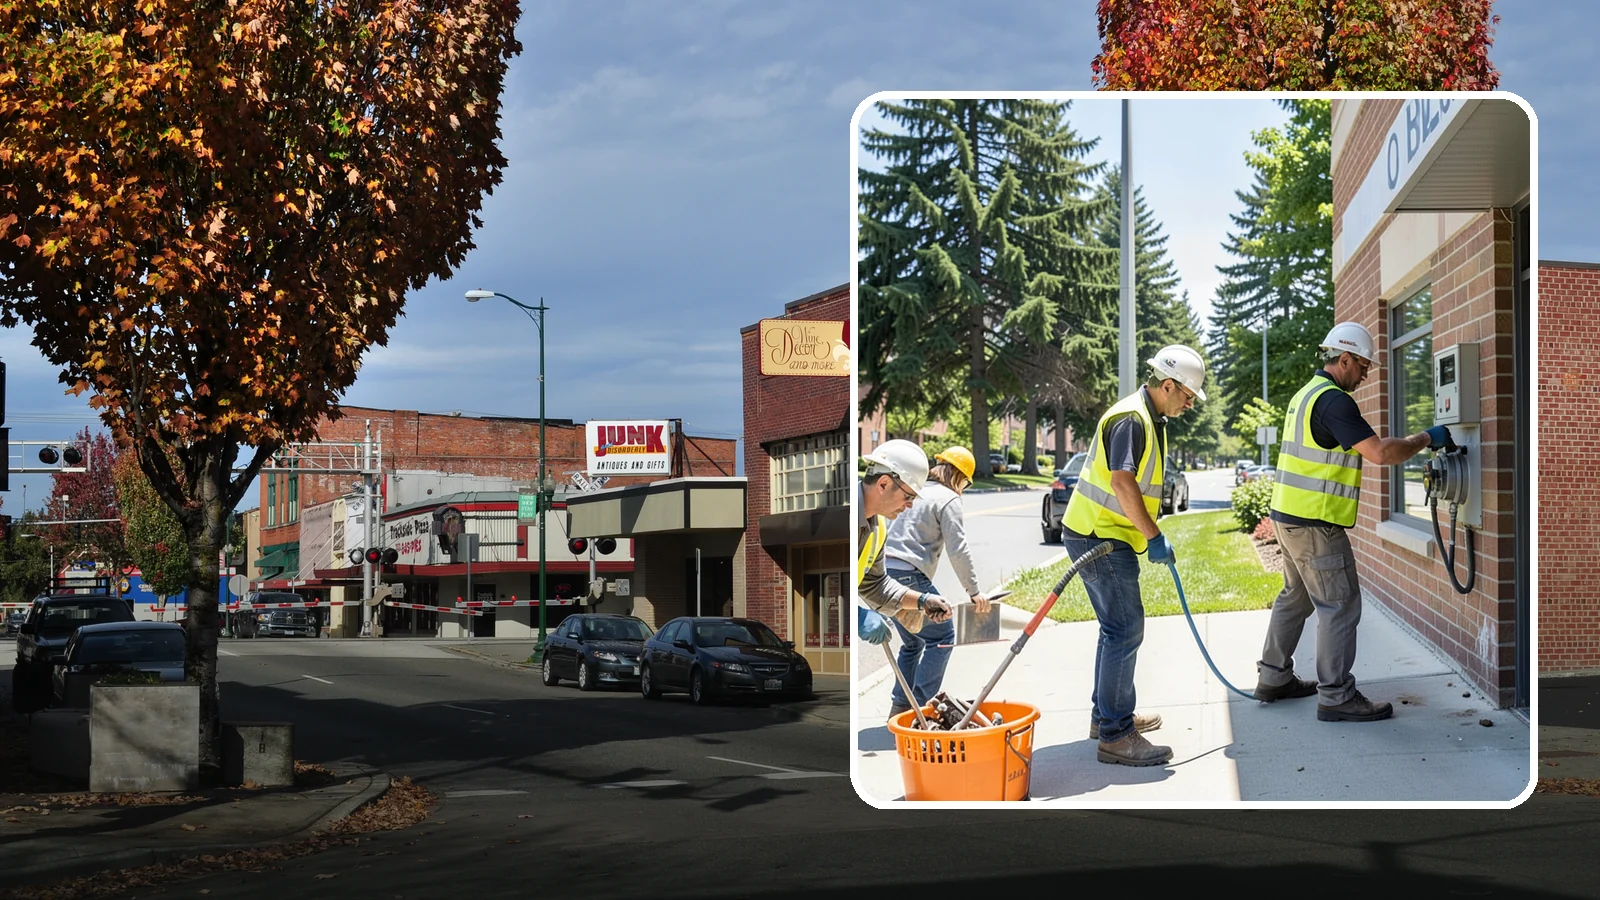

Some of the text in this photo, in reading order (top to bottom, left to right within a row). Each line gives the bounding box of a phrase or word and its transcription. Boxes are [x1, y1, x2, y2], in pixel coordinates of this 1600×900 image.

[595, 425, 664, 457] JUNK
[607, 446, 646, 454] DISORDERLY
[597, 460, 665, 470] ANTIQUES AND GIFTS
[390, 519, 429, 540] Trackside Pizza
